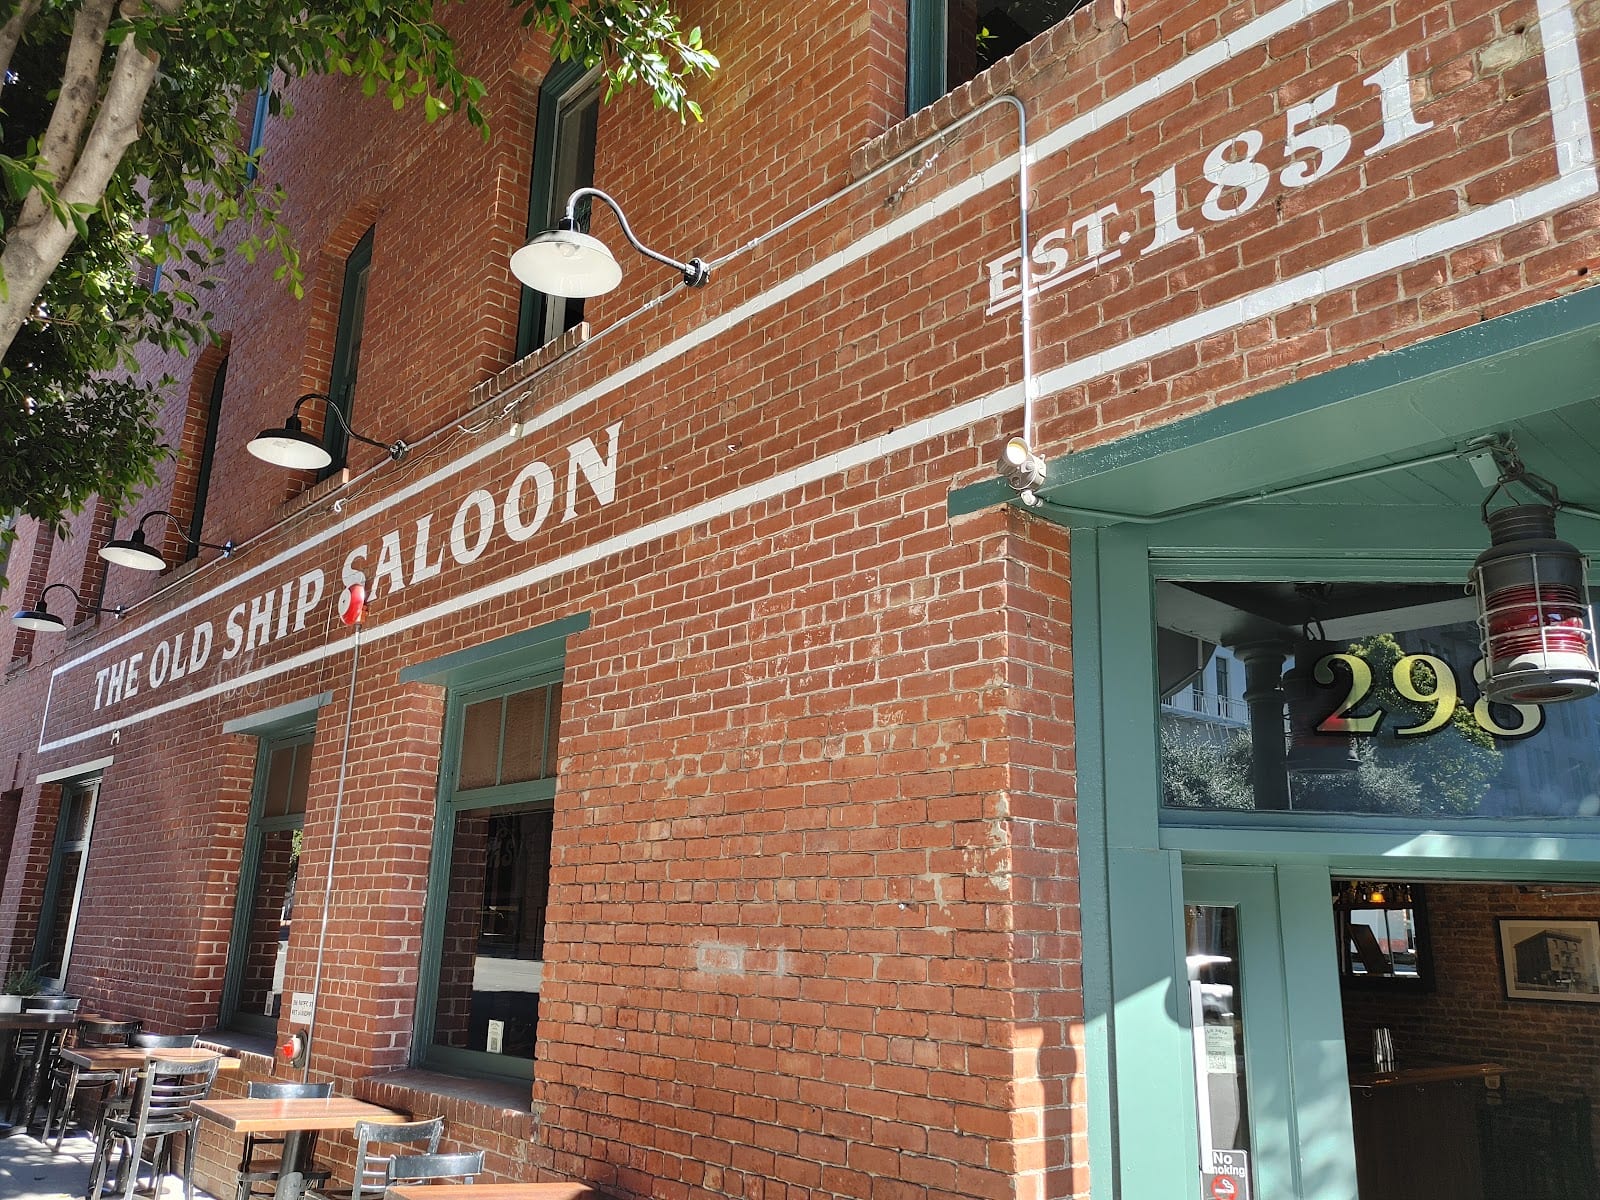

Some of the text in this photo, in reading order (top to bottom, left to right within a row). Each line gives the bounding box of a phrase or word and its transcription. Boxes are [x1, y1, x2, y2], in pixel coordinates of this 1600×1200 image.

[985, 50, 1434, 303] EST. 1851
[93, 420, 624, 711] THE OLD SHIP SALOON
[1212, 1152, 1233, 1165] No
[1212, 1165, 1246, 1178] moking
